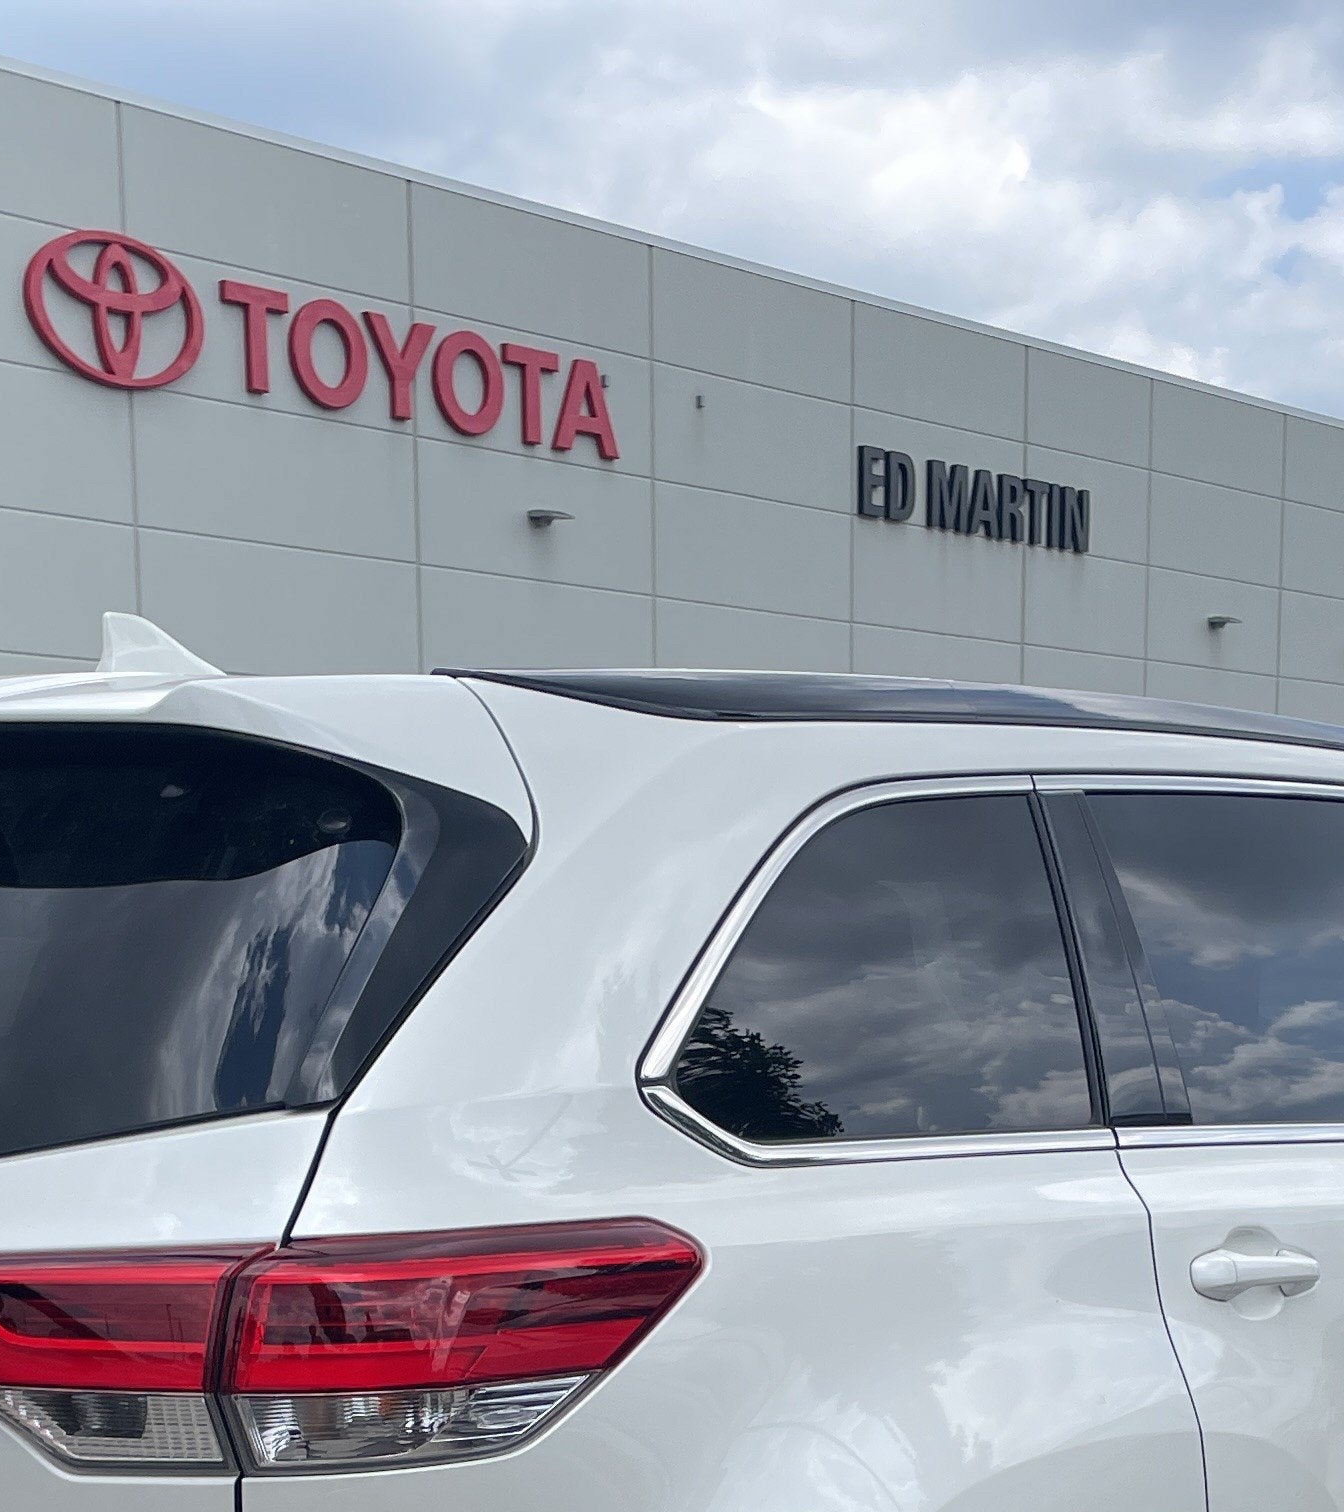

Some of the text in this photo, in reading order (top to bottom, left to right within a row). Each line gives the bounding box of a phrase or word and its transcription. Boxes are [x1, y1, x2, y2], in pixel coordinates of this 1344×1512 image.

[219, 279, 619, 460] TOYOTA
[856, 445, 1090, 553] ED MARTIN
